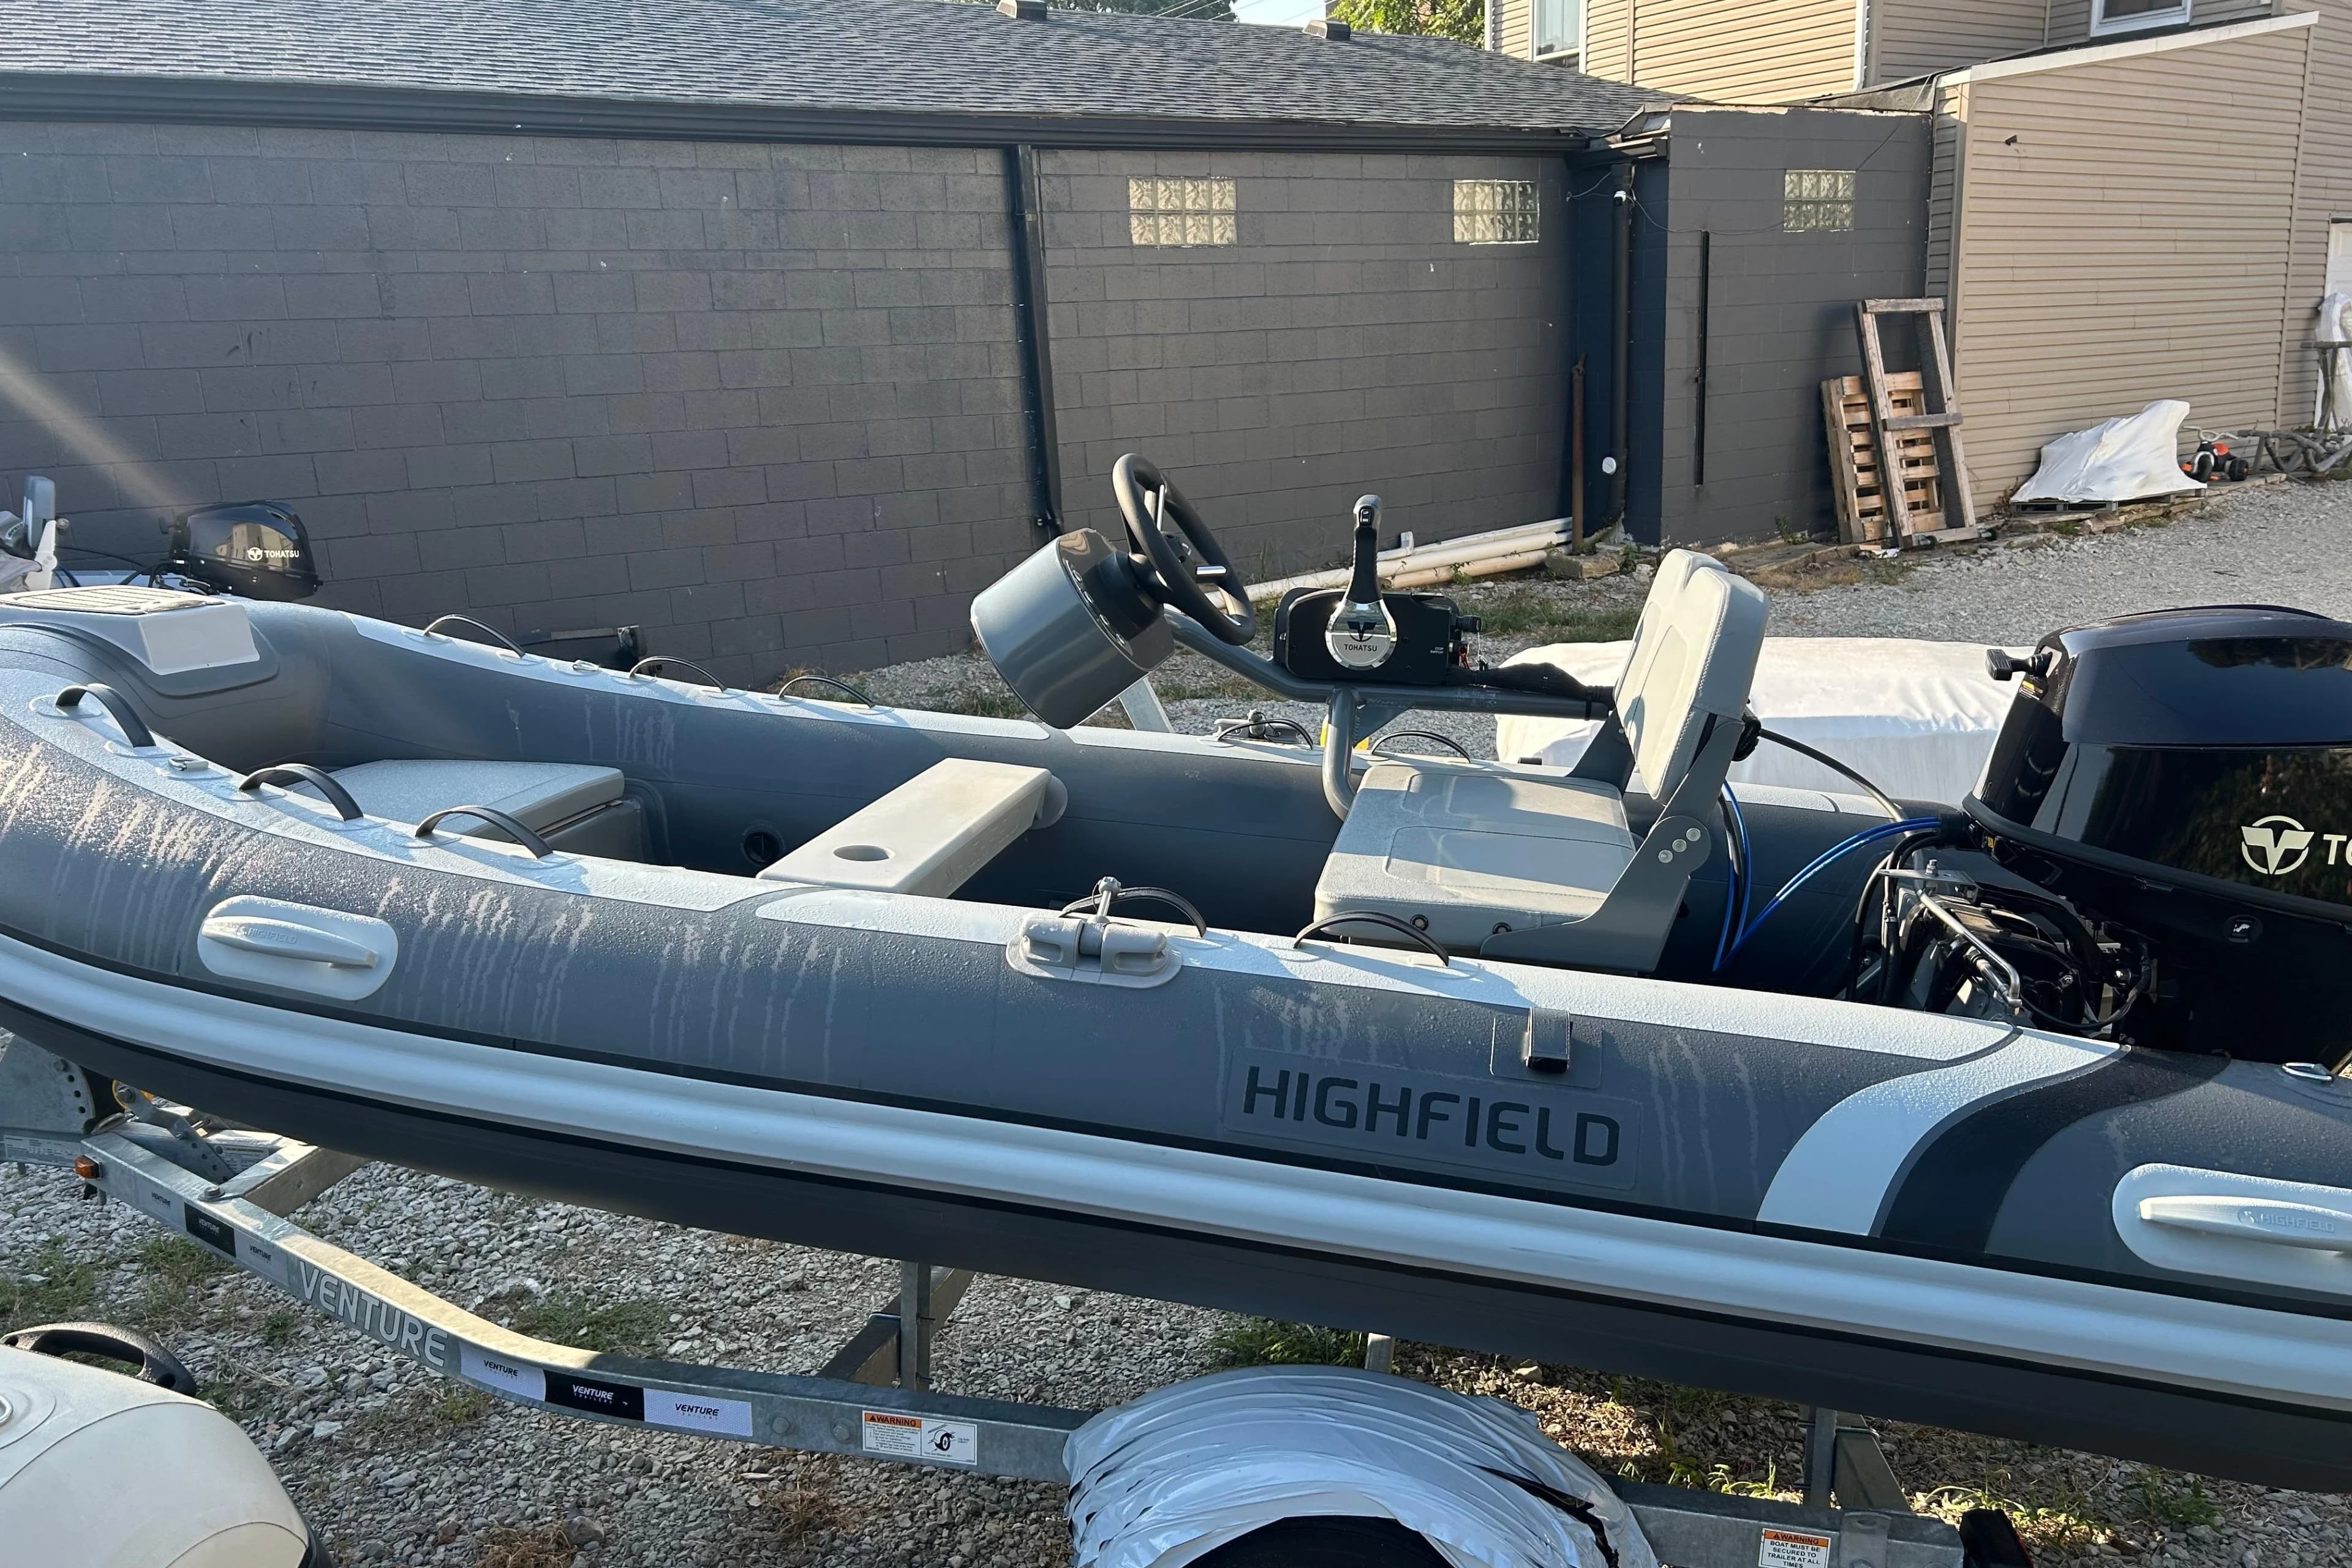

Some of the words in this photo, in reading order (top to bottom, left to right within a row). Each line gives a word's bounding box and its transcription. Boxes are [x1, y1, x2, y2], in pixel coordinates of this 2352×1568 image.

[2323, 834, 2352, 867] T
[247, 927, 298, 944] HIGHFIELD
[1243, 1065, 1621, 1167] HIGHFIELD
[2260, 1213, 2335, 1233] HIGHFIELD
[249, 1244, 271, 1261] VENTURE
[299, 1260, 449, 1368] VENTURE
[483, 1359, 519, 1377] VENTURE
[572, 1384, 614, 1400] VENTURE
[675, 1403, 720, 1417] VENTURE
[876, 1415, 916, 1427] WARNING
[1781, 1533, 1819, 1545] WARNING
[1767, 1552, 1796, 1561] TRAILER
[1773, 1547, 1806, 1556] SECURED
